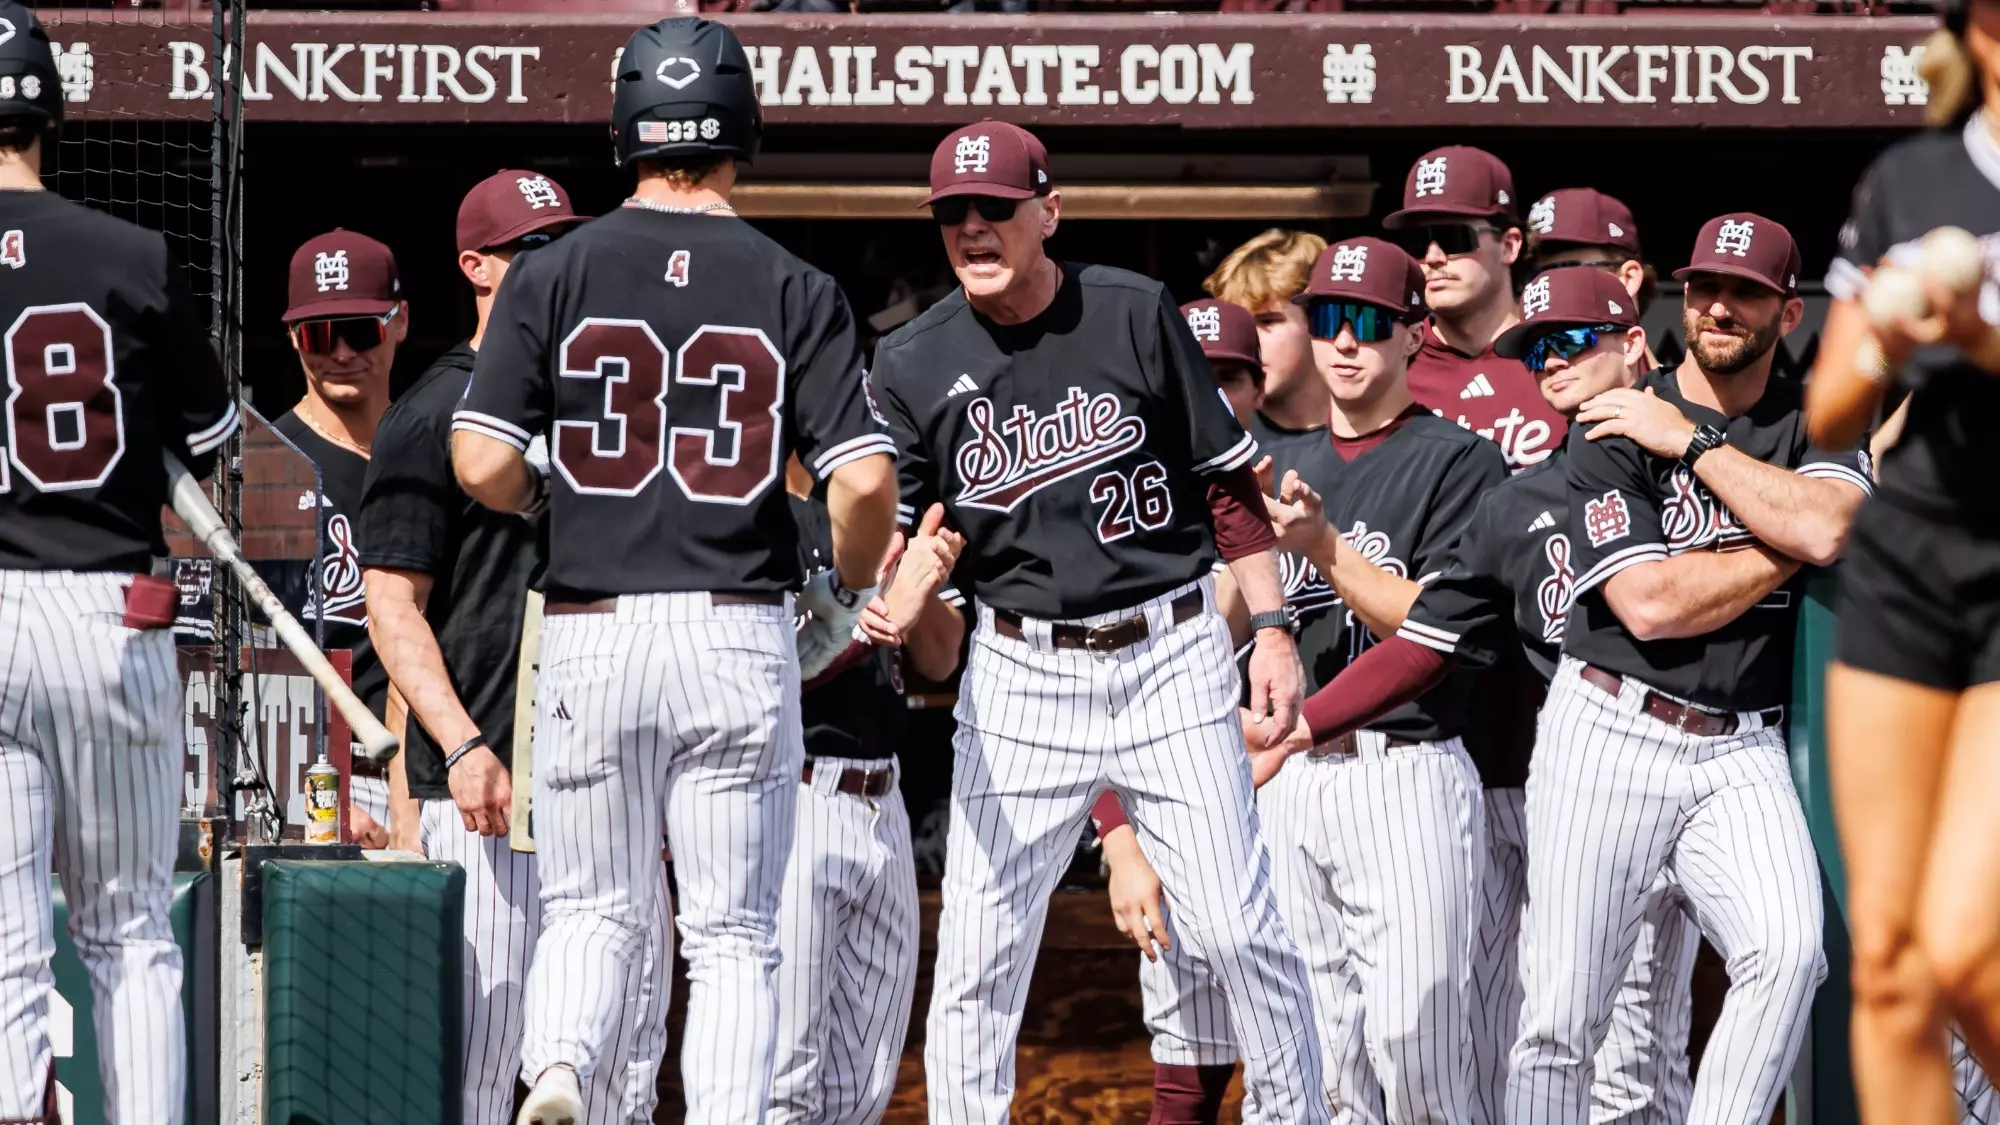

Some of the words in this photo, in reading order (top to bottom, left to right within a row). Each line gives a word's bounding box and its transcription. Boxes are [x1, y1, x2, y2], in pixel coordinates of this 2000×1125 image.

[167, 41, 541, 103] BANKFIRST
[741, 43, 1255, 106] HAILSTATE.COM
[1445, 44, 1813, 104] BANKFIRST
[667, 120, 698, 142] 33
[0, 301, 126, 494] 8
[551, 316, 787, 506] 33
[955, 386, 1146, 508] State
[1089, 460, 1173, 544] 26
[185, 670, 315, 826] SATE
